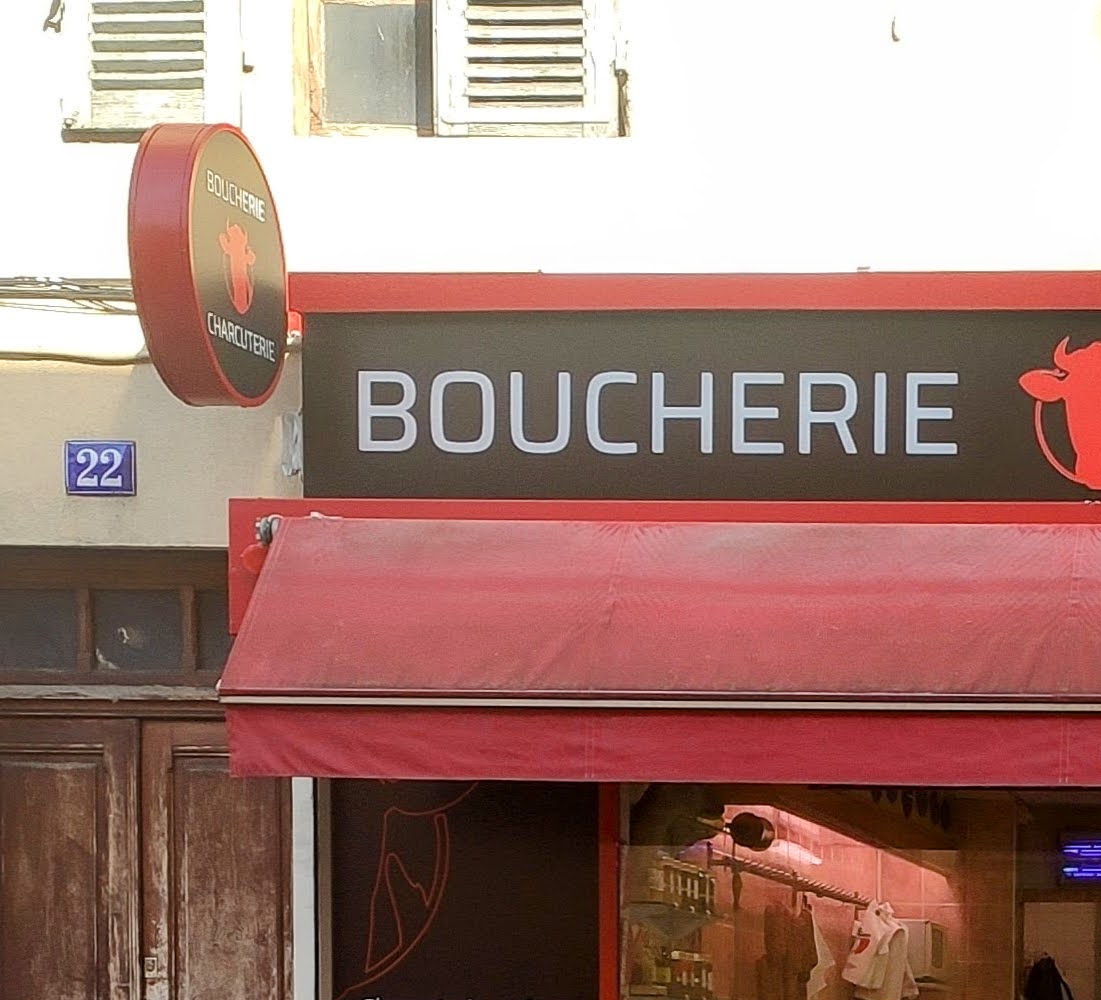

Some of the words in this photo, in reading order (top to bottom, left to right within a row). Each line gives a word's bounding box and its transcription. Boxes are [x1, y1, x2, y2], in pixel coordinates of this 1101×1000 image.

[206, 169, 266, 223] BOUCHERIE
[207, 311, 276, 363] CHARCUTERIE
[357, 370, 959, 456] BOUCHERIE
[76, 448, 123, 488] 22
